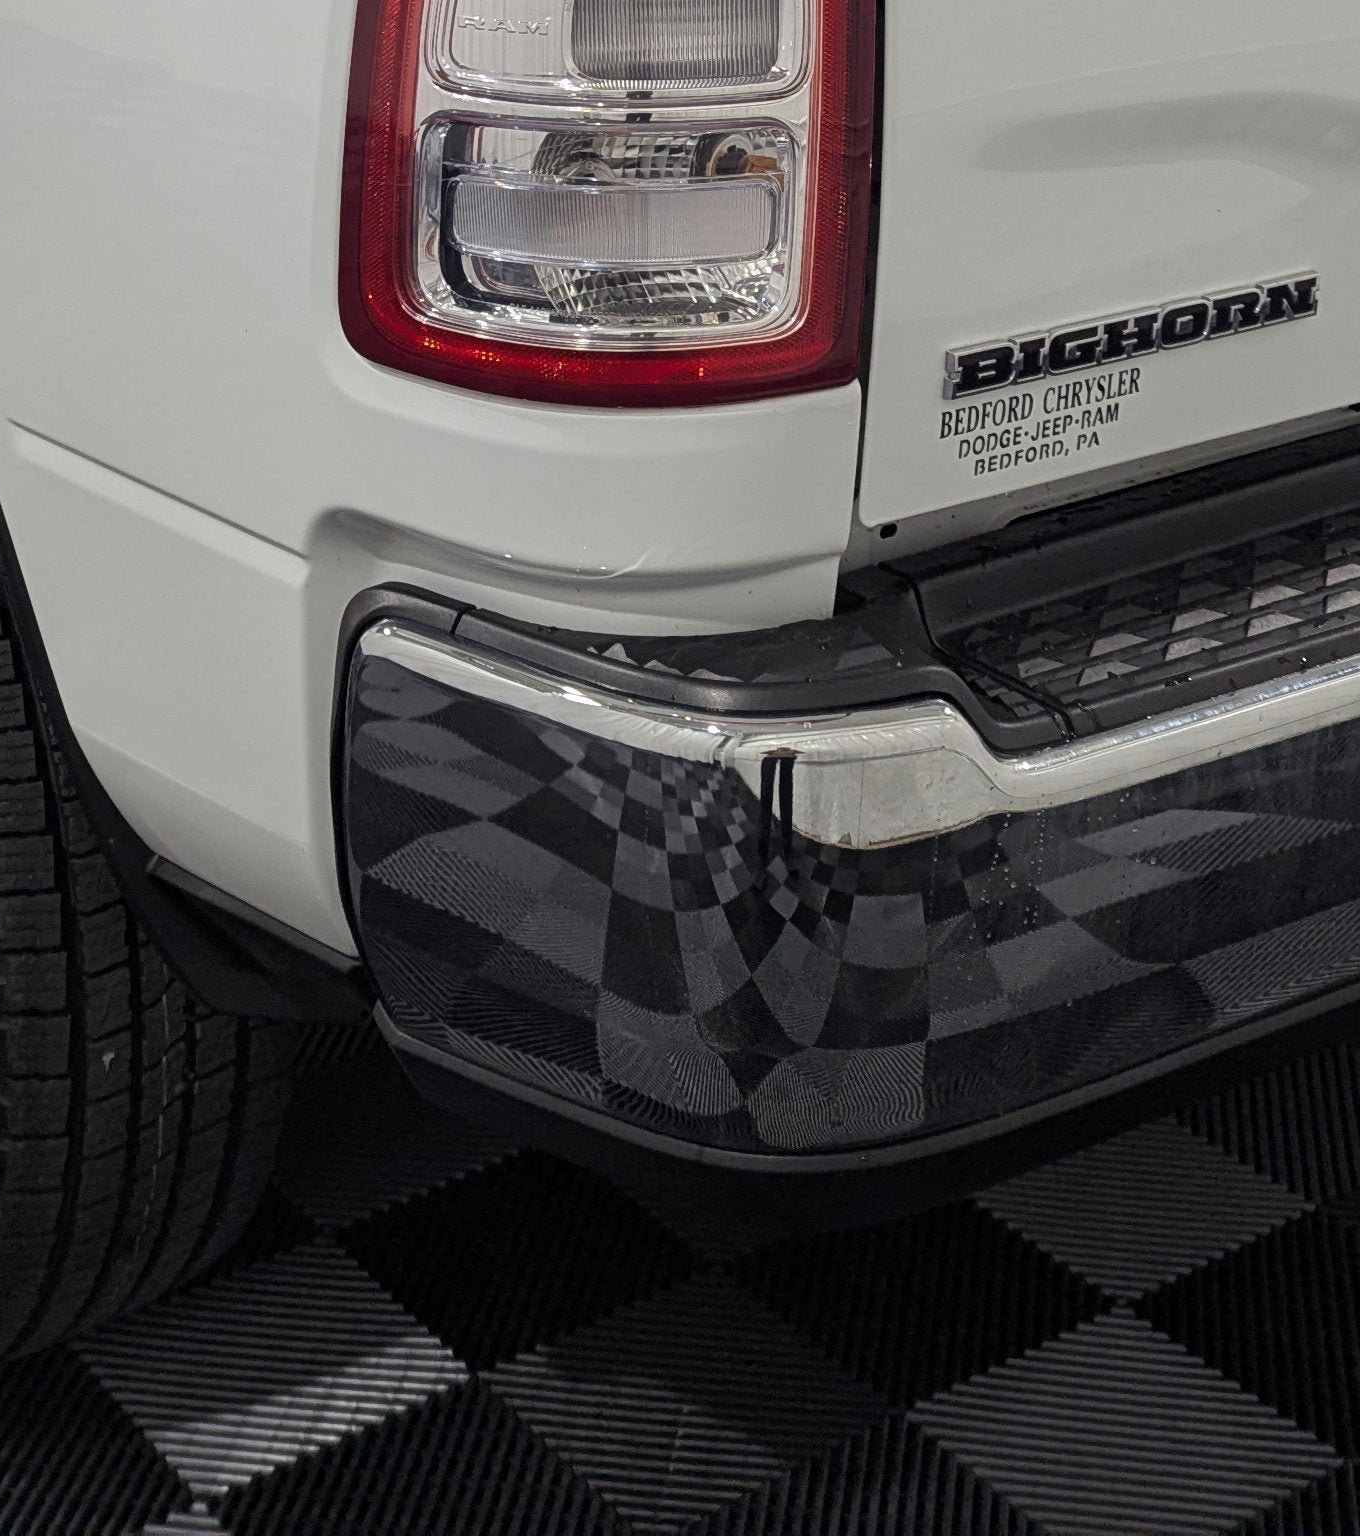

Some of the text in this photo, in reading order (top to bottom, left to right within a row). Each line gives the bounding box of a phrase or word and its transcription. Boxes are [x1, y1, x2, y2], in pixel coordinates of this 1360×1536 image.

[457, 15, 552, 36] RAM
[943, 270, 1320, 400] BIGHORN
[939, 367, 1141, 440] BEDFORD CHRYSLER
[974, 432, 1100, 477] BEDFORD, PA
